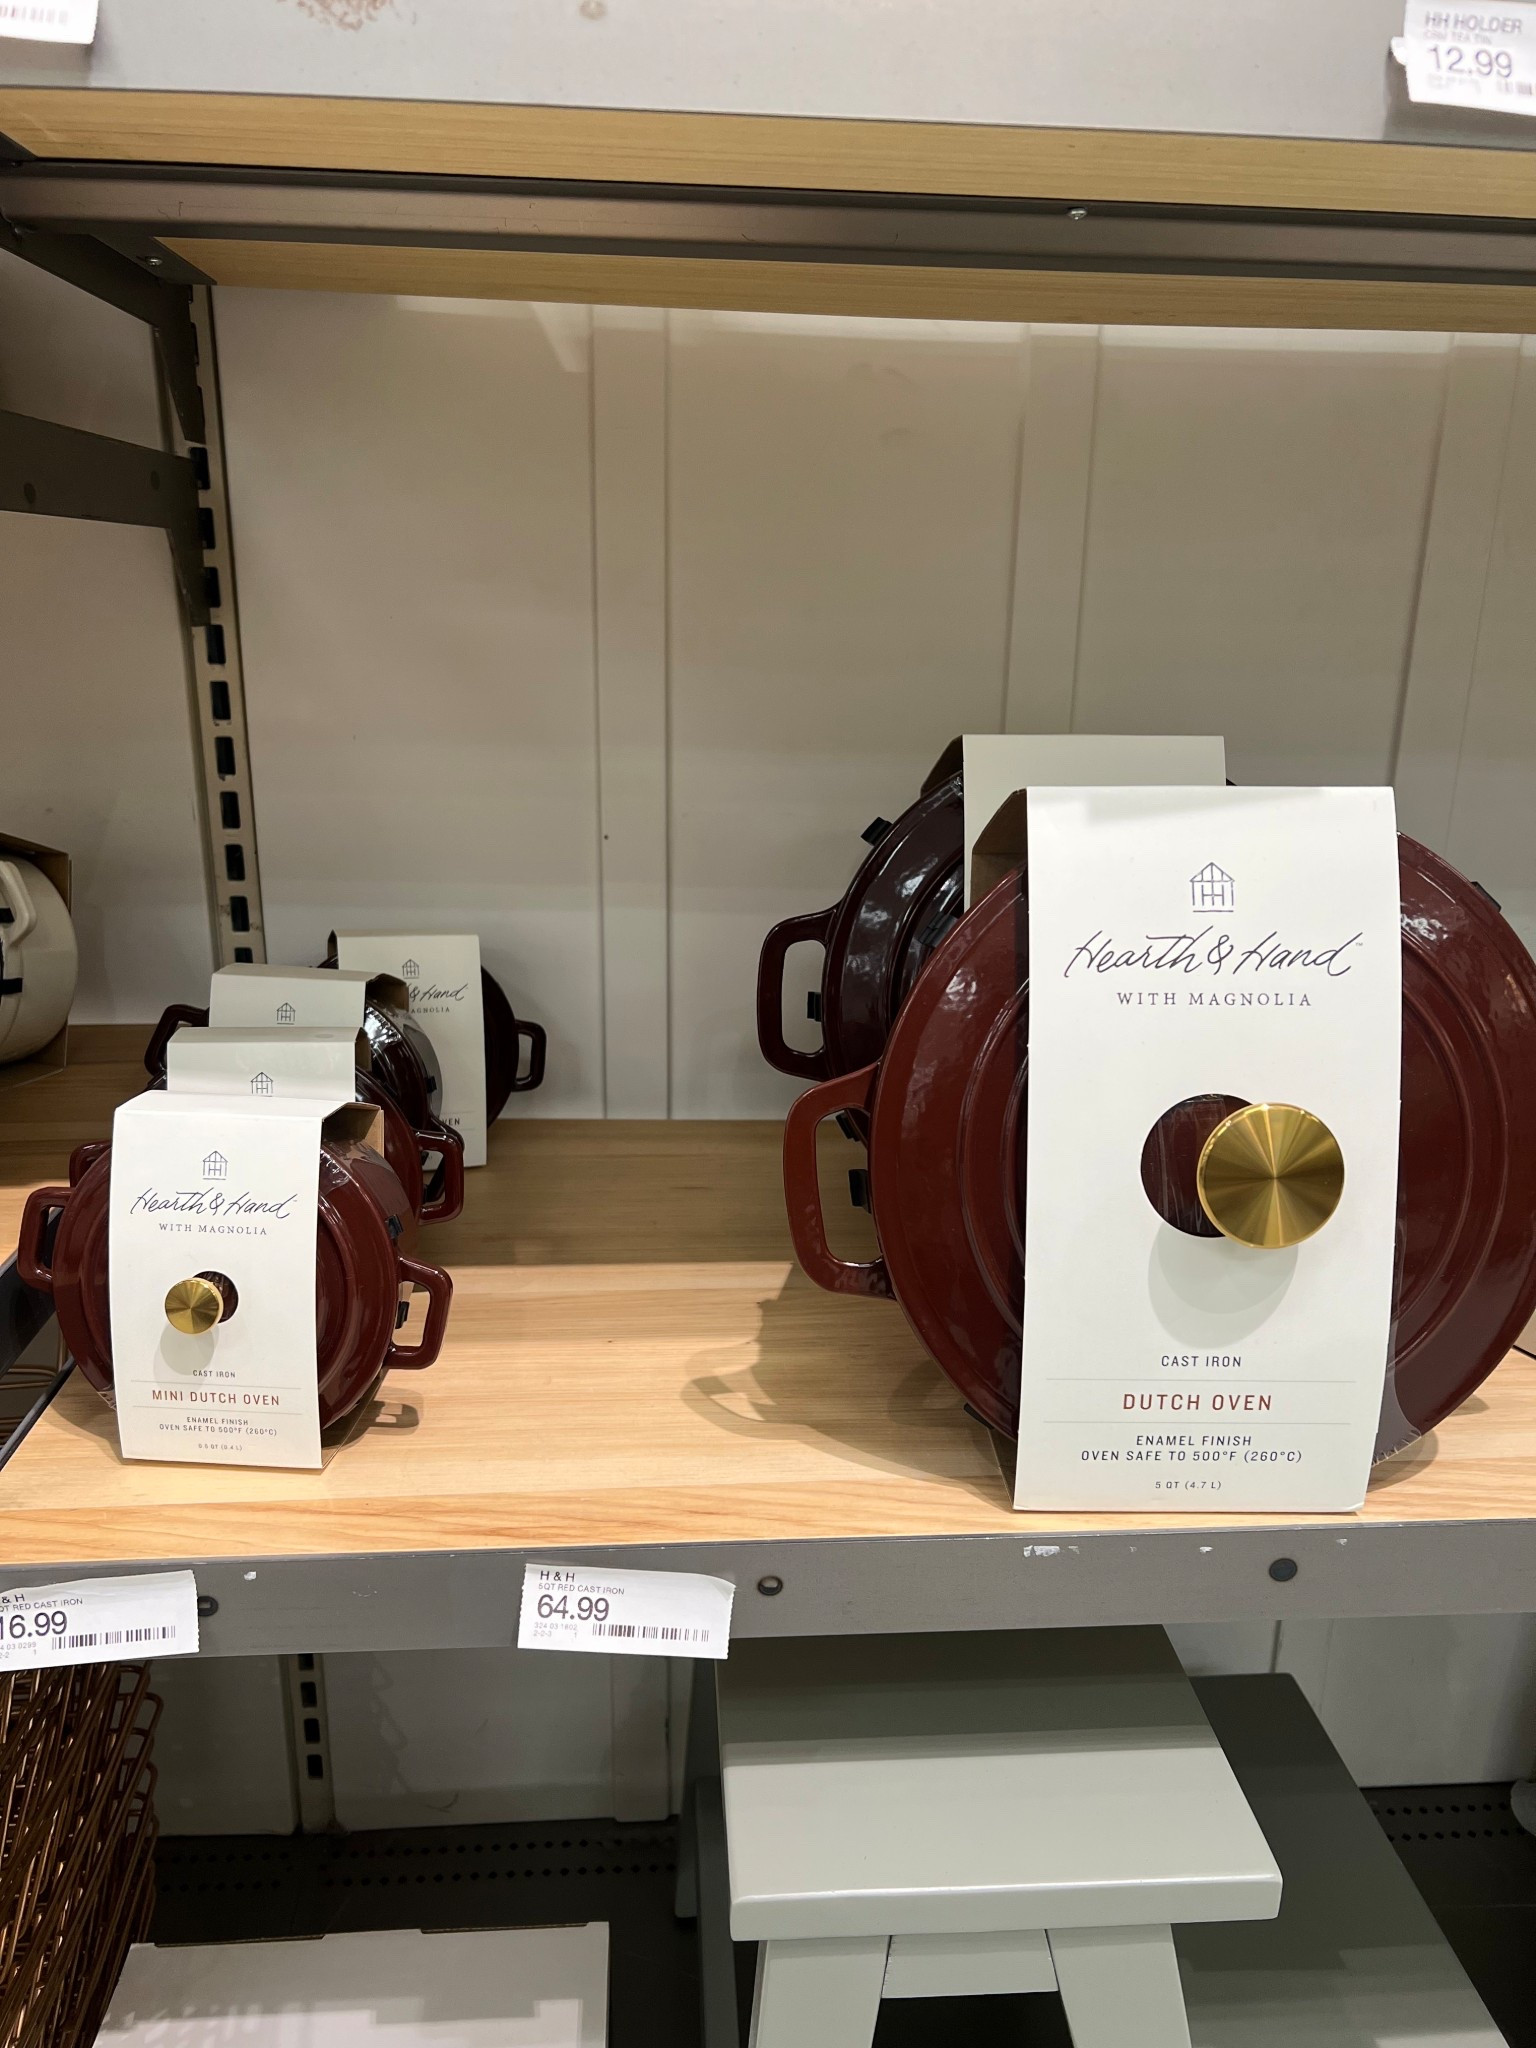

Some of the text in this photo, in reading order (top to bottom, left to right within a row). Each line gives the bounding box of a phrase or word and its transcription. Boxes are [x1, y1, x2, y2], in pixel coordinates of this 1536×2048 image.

[1425, 11, 1522, 33] HH HOLDER
[1428, 45, 1512, 78] 12.99
[1064, 926, 1214, 978] Hearth
[1207, 934, 1234, 975] &
[409, 983, 468, 1002] & Hand
[1117, 992, 1312, 1007] WITH MAGNOLIA
[411, 1006, 450, 1014] AGNOLIA
[442, 1117, 460, 1126] VEN
[130, 1187, 214, 1215] Hearth
[208, 1192, 225, 1216] &
[159, 1223, 267, 1235] WITH MAGNOLIA
[1161, 1355, 1242, 1368] CAST IRON
[193, 1369, 236, 1379] CAST IRON
[152, 1390, 280, 1406] MINI DUTCH OVEN
[1123, 1393, 1272, 1411] DUTCH OVEN
[159, 1423, 180, 1431] OVEN
[183, 1424, 203, 1432] SAFE
[205, 1425, 216, 1433] TO
[187, 1416, 249, 1426] ENAMEL FINISH
[1136, 1435, 1252, 1447] ENAMEL FINISH
[1081, 1450, 1302, 1464] OVEN SAFE TO 500°F (260°C)
[1155, 1481, 1222, 1491] 5 QT (4.7 L)
[540, 1570, 576, 1582] H & H
[538, 1582, 626, 1596] 5QT RED CAST IRON
[1, 1593, 26, 1604] & H
[13, 1603, 31, 1612] RED
[33, 1600, 58, 1609] CAST
[60, 1598, 83, 1607] IRON
[537, 1594, 610, 1622] 64.99
[0, 1610, 68, 1640] 16.99
